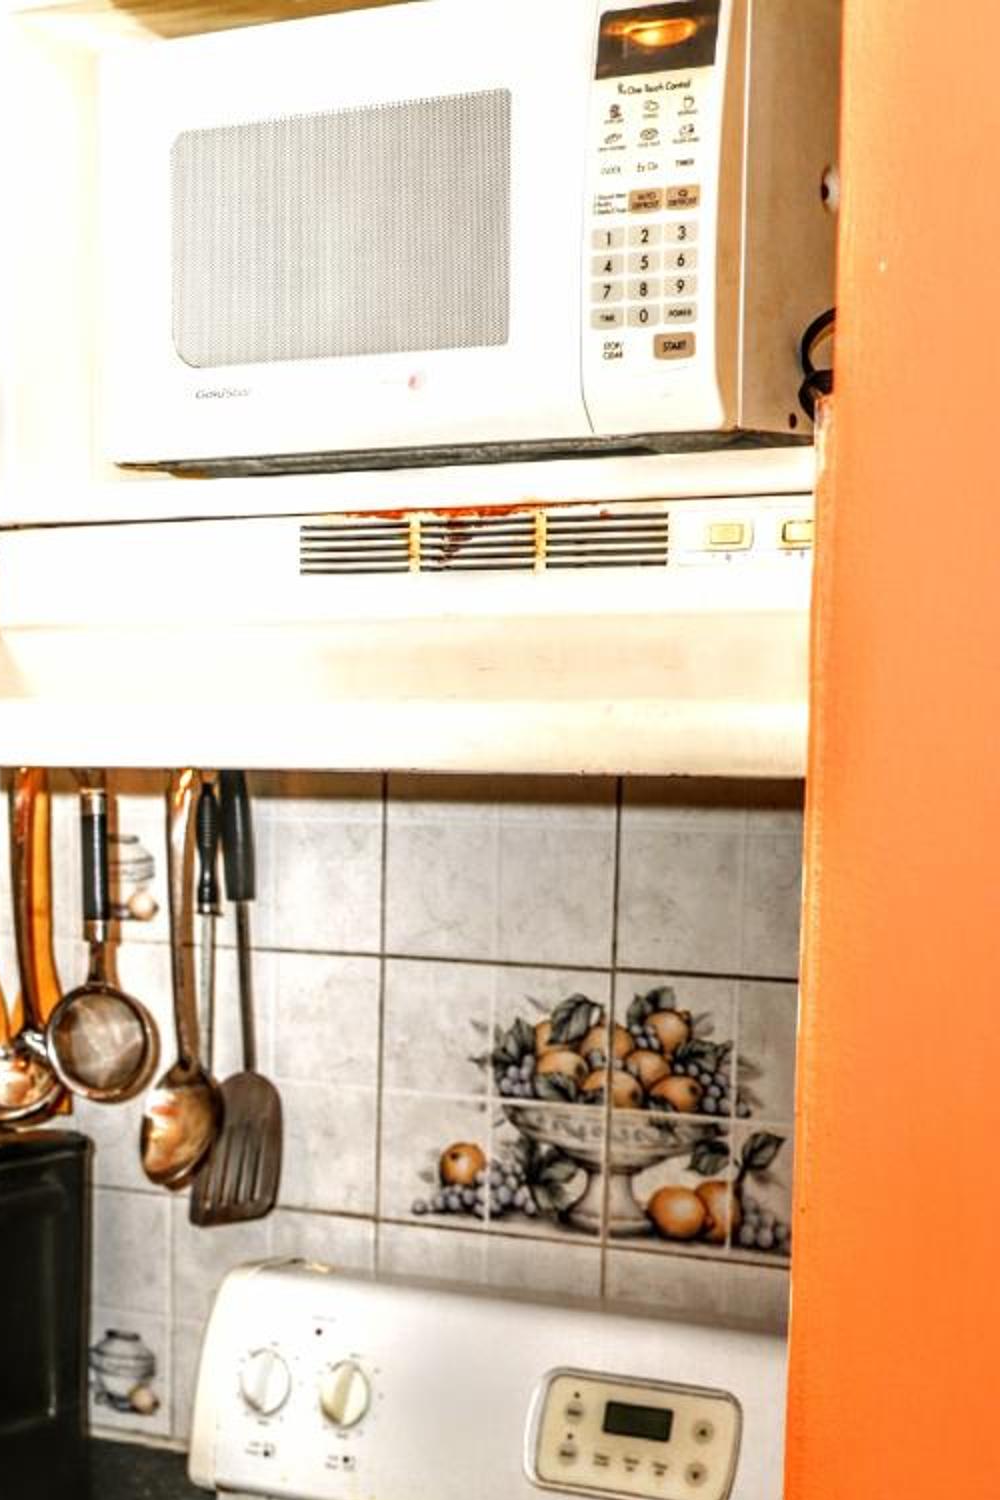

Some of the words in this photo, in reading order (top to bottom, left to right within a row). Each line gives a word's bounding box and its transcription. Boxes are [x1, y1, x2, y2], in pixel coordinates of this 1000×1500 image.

[606, 231, 611, 247] 1
[641, 228, 649, 243] 2
[677, 225, 687, 241] 3
[603, 260, 613, 273] 4
[640, 254, 649, 271] 5
[677, 252, 685, 267] 6
[603, 283, 611, 299] 7
[640, 281, 648, 298] 8
[676, 278, 685, 294] 9
[639, 308, 649, 324] 0
[663, 340, 687, 353] START
